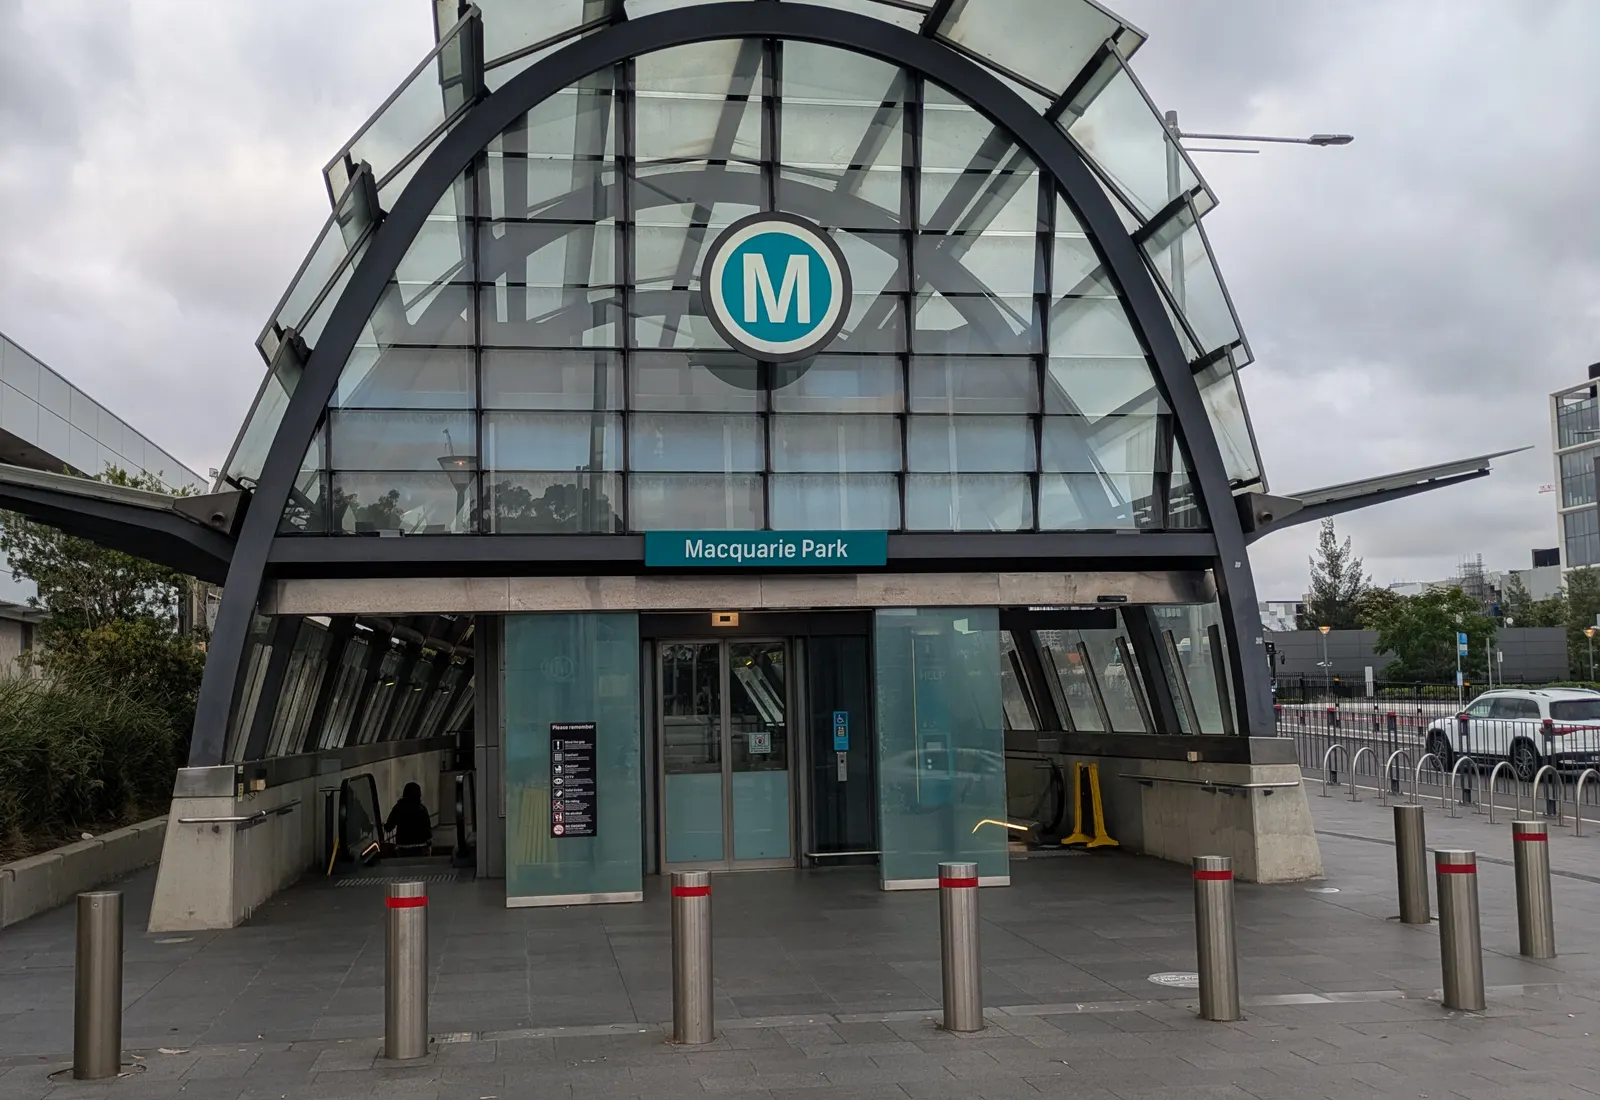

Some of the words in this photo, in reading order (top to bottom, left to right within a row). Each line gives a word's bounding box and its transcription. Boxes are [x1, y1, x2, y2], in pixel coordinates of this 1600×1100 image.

[742, 252, 812, 324] M
[685, 539, 796, 563] Macquarie
[801, 538, 849, 558] Park
